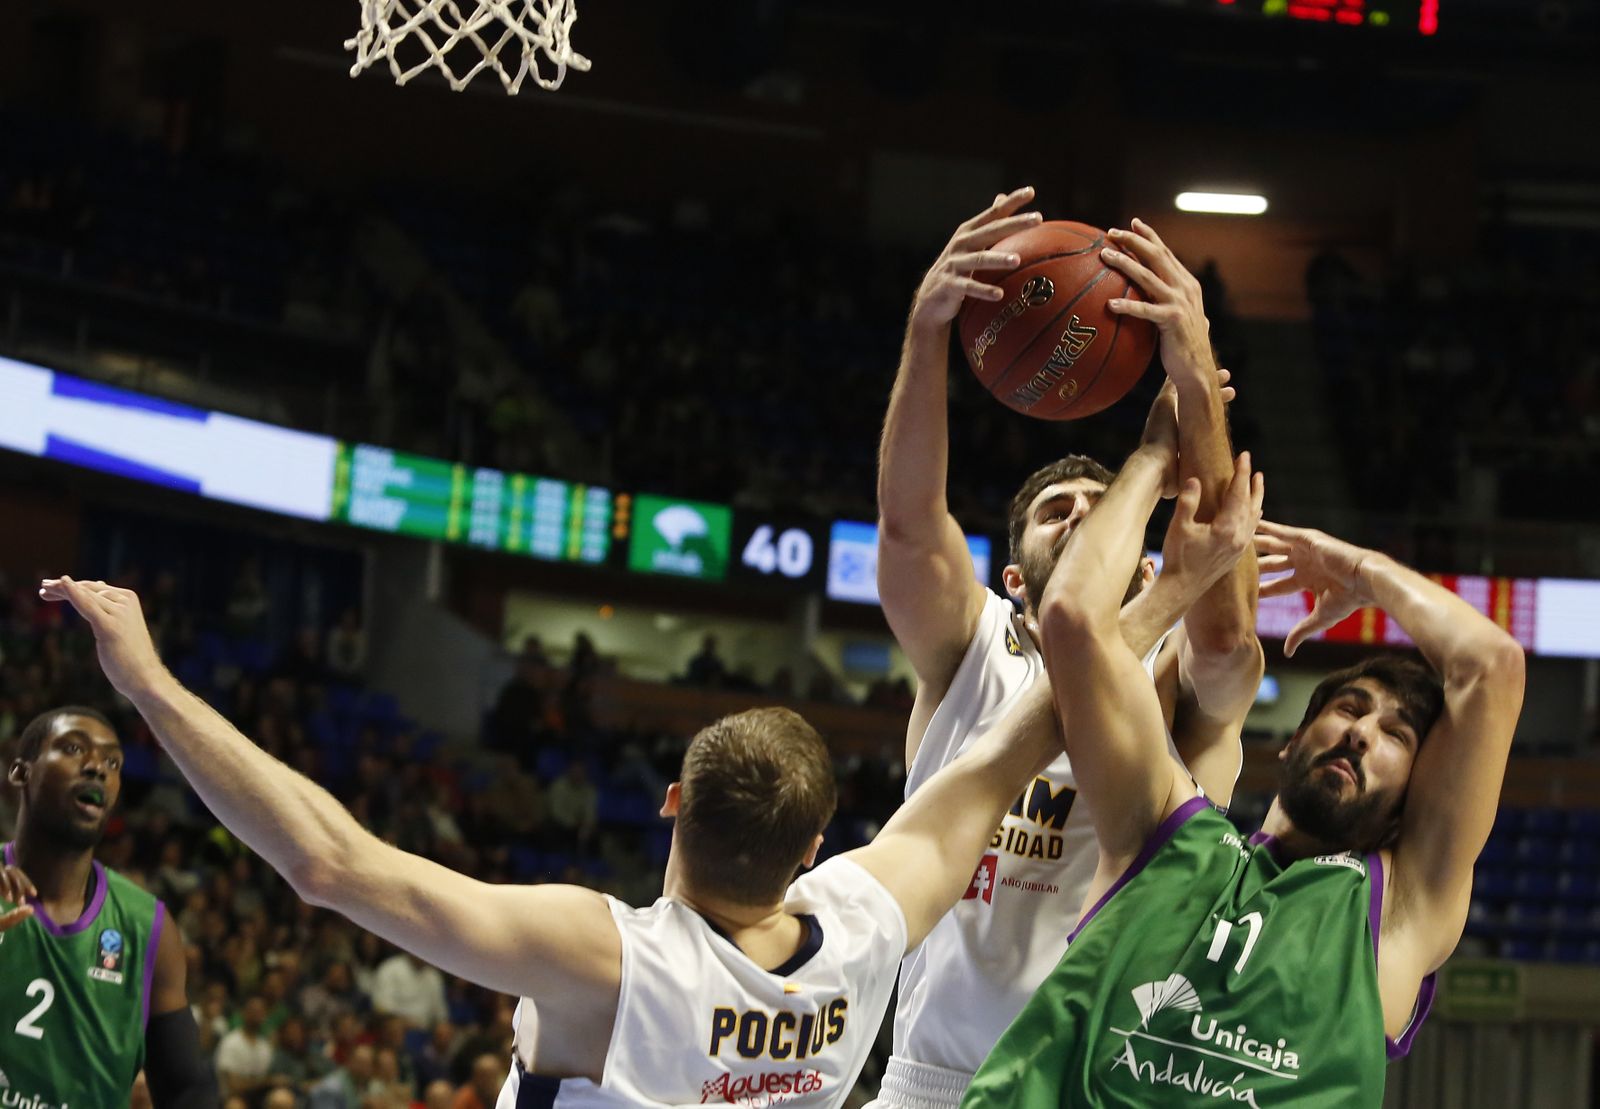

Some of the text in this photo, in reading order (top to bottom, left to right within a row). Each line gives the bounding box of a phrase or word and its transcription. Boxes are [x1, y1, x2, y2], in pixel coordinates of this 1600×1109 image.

[1007, 314, 1098, 412] SPALDIN
[741, 524, 814, 578] 40
[15, 978, 55, 1040] 2
[708, 996, 849, 1062] POCIUS
[1191, 1014, 1300, 1070] Unicaja
[700, 1069, 823, 1105] Apuestas
[1110, 1038, 1262, 1109] Andalucía
